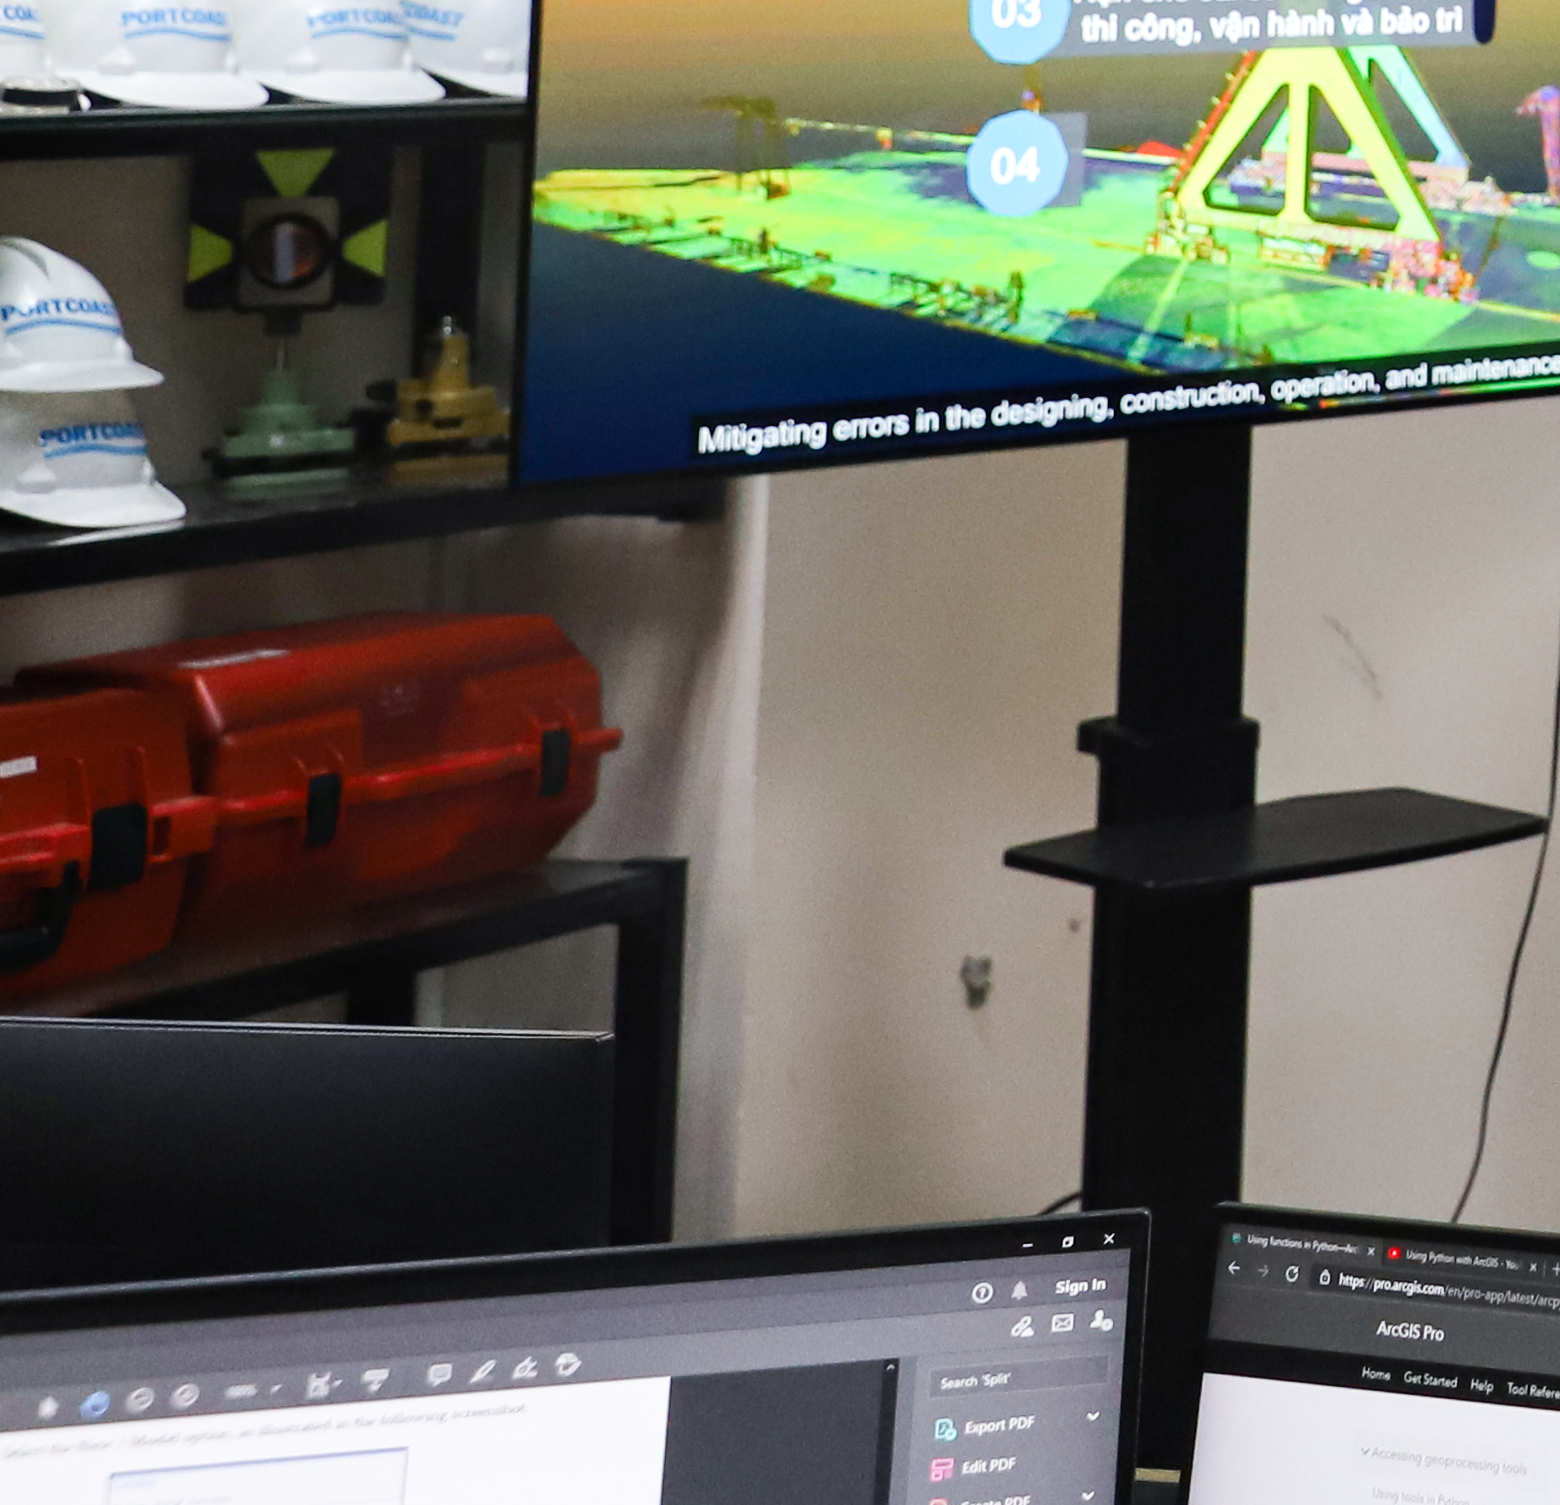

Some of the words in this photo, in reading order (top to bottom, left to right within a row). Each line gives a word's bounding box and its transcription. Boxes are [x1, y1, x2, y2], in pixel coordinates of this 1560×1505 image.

[121, 7, 228, 27] PORTCOAS
[1081, 13, 1117, 43] thi
[1124, 12, 1202, 46] công,
[1209, 10, 1260, 43] vận
[1267, 7, 1334, 38] hành
[1340, 7, 1374, 35] và
[990, 147, 1040, 184] 04
[698, 419, 827, 456] Mitigating
[833, 413, 910, 442] errors
[915, 407, 940, 434] in
[946, 403, 986, 432] the
[991, 393, 1114, 428] designing,
[1120, 379, 1266, 416] construction,
[1271, 370, 1382, 405] operation,
[1386, 362, 1428, 391] and
[1247, 1233, 1268, 1247] Using
[1269, 1234, 1303, 1250] functions
[1304, 1239, 1311, 1250] in
[1406, 1250, 1427, 1264] Using
[1428, 1251, 1455, 1266] Python
[1457, 1254, 1473, 1266] with
[1473, 1255, 1499, 1268] ArcGIS
[1055, 1279, 1088, 1297] Sign
[1092, 1278, 1106, 1291] In
[1376, 1319, 1421, 1340] ArcGIS
[1423, 1323, 1445, 1342] Pro
[940, 1374, 978, 1390] Search
[1362, 1366, 1391, 1381] Home
[1404, 1370, 1422, 1385] Get
[1423, 1373, 1458, 1389] Started
[1470, 1378, 1494, 1395] Help
[1507, 1381, 1529, 1396] Tool
[965, 1418, 1006, 1437] Export
[1009, 1415, 1035, 1432] PDF
[962, 1459, 987, 1475] Edit
[990, 1457, 1017, 1472] PDF
[1371, 1447, 1423, 1467] Accessing
[1424, 1454, 1500, 1475] geoprocessing
[1502, 1463, 1528, 1475] tools
[1372, 1487, 1399, 1504] Using
[1401, 1492, 1425, 1504] tools
